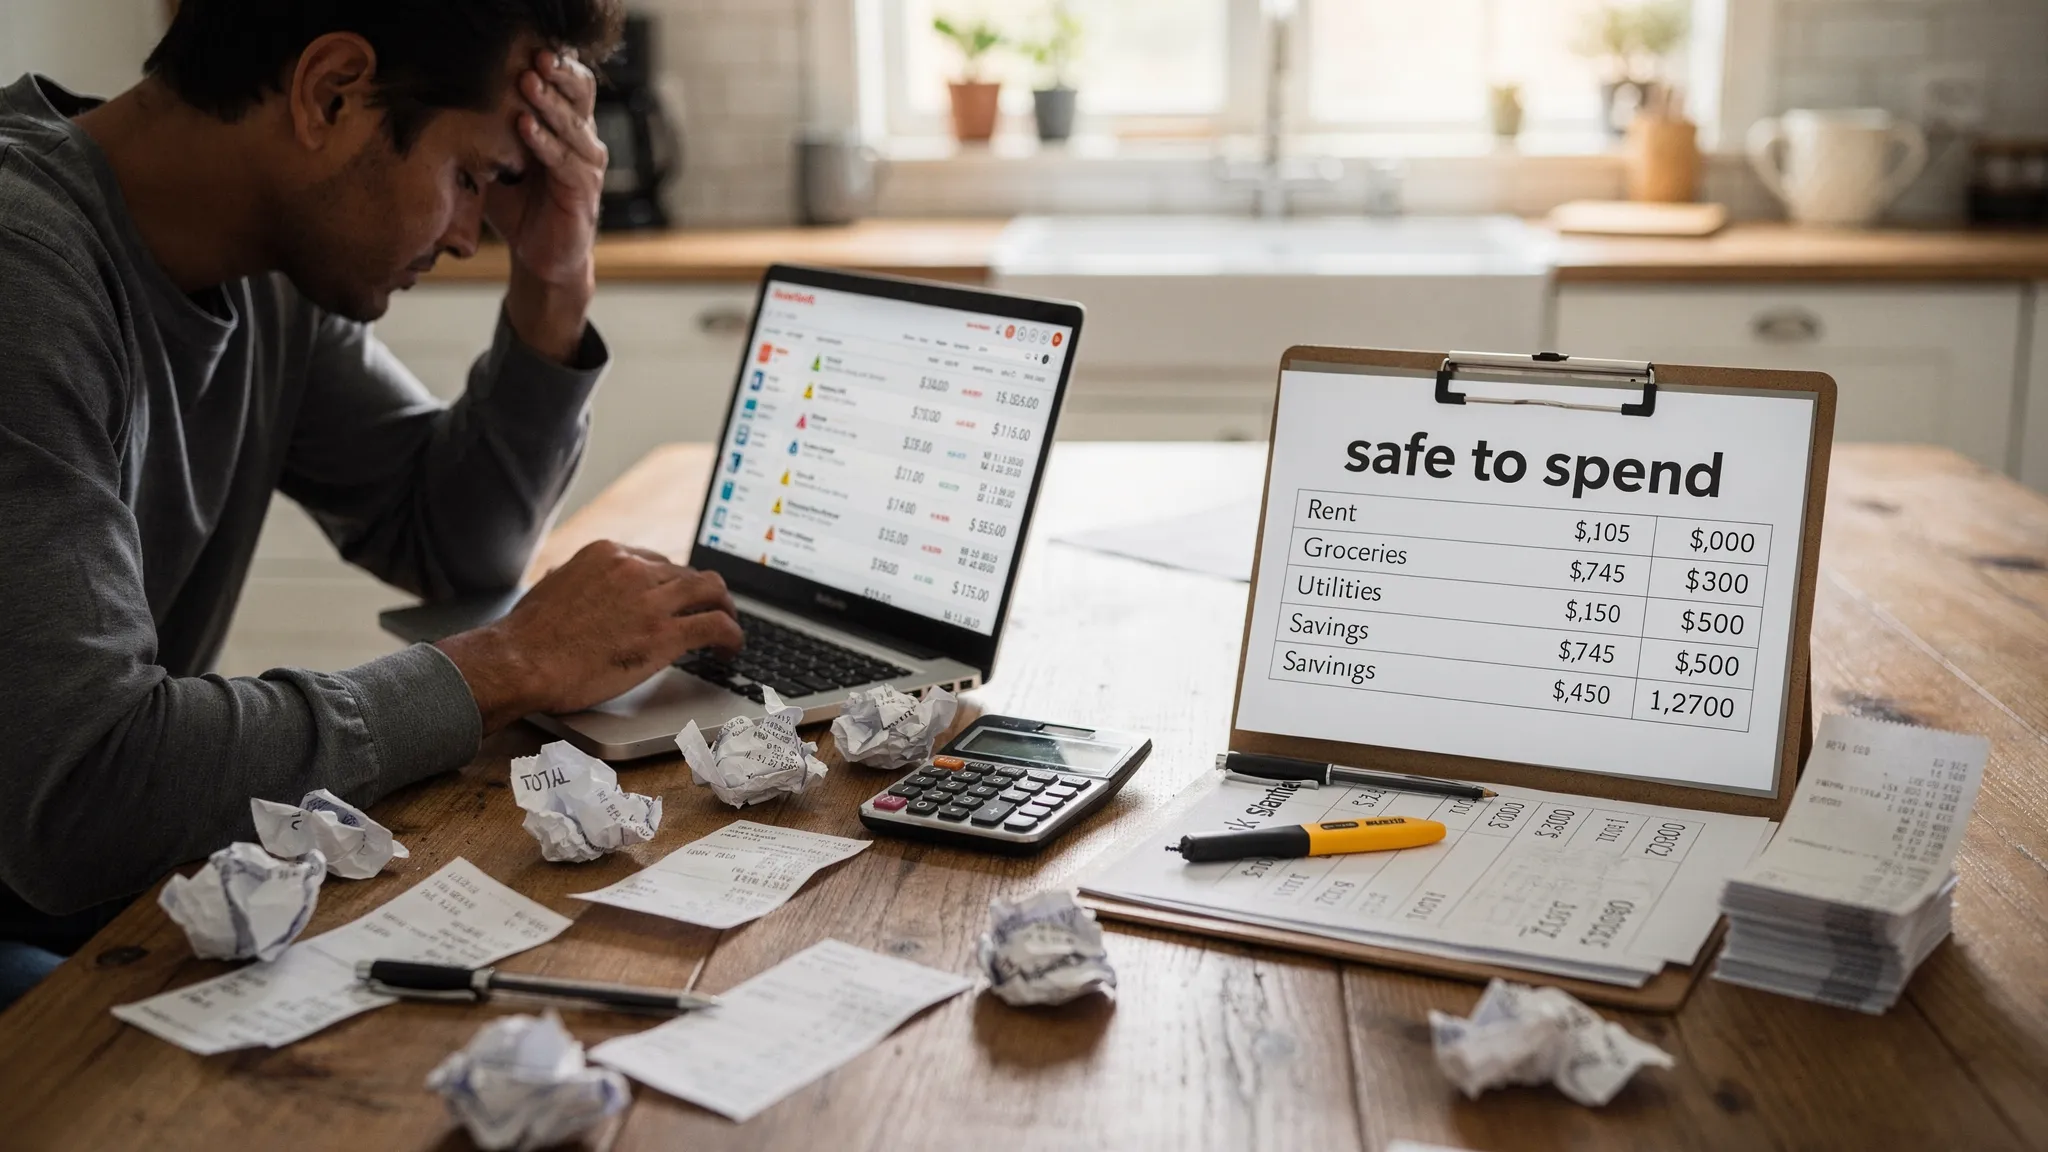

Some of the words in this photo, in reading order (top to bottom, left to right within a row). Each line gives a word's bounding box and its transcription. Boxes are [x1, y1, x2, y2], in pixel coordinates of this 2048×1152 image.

[1344, 432, 1455, 478] safe
[1472, 440, 1527, 483] to
[1543, 452, 1723, 499] spend
[1307, 499, 1357, 522] Rent
[1575, 520, 1630, 543] $,105
[1690, 527, 1755, 553] $,000
[1303, 537, 1408, 564] Groceries
[1570, 560, 1625, 583] $,745
[1686, 567, 1749, 594] $300
[1298, 575, 1382, 601] Utilities
[1565, 599, 1621, 623] $,150
[1681, 609, 1744, 635] $500
[1290, 612, 1369, 645] Savings
[1559, 639, 1615, 663] $,745
[1675, 650, 1739, 677] $,500
[1553, 679, 1611, 704] $,450
[1651, 690, 1734, 718] 1,2700
